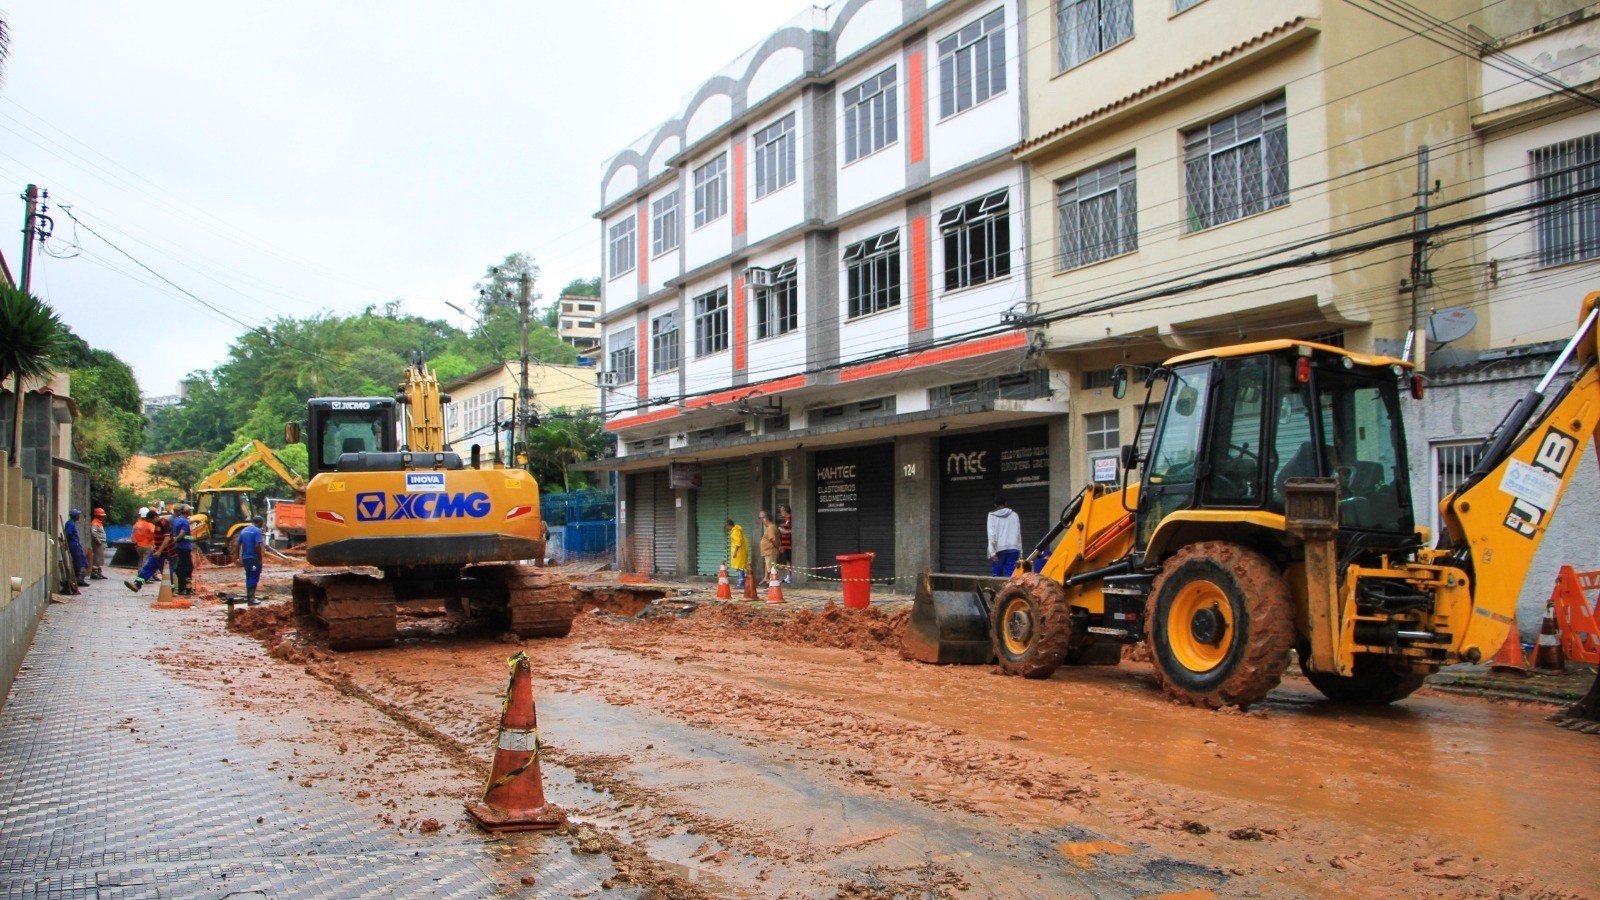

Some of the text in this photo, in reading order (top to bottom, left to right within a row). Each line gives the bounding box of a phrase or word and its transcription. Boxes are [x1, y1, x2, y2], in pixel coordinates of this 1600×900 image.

[410, 475, 440, 484] INOVA
[903, 464, 916, 476] 124
[1505, 432, 1575, 535] JB
[387, 492, 491, 520] XCMG
